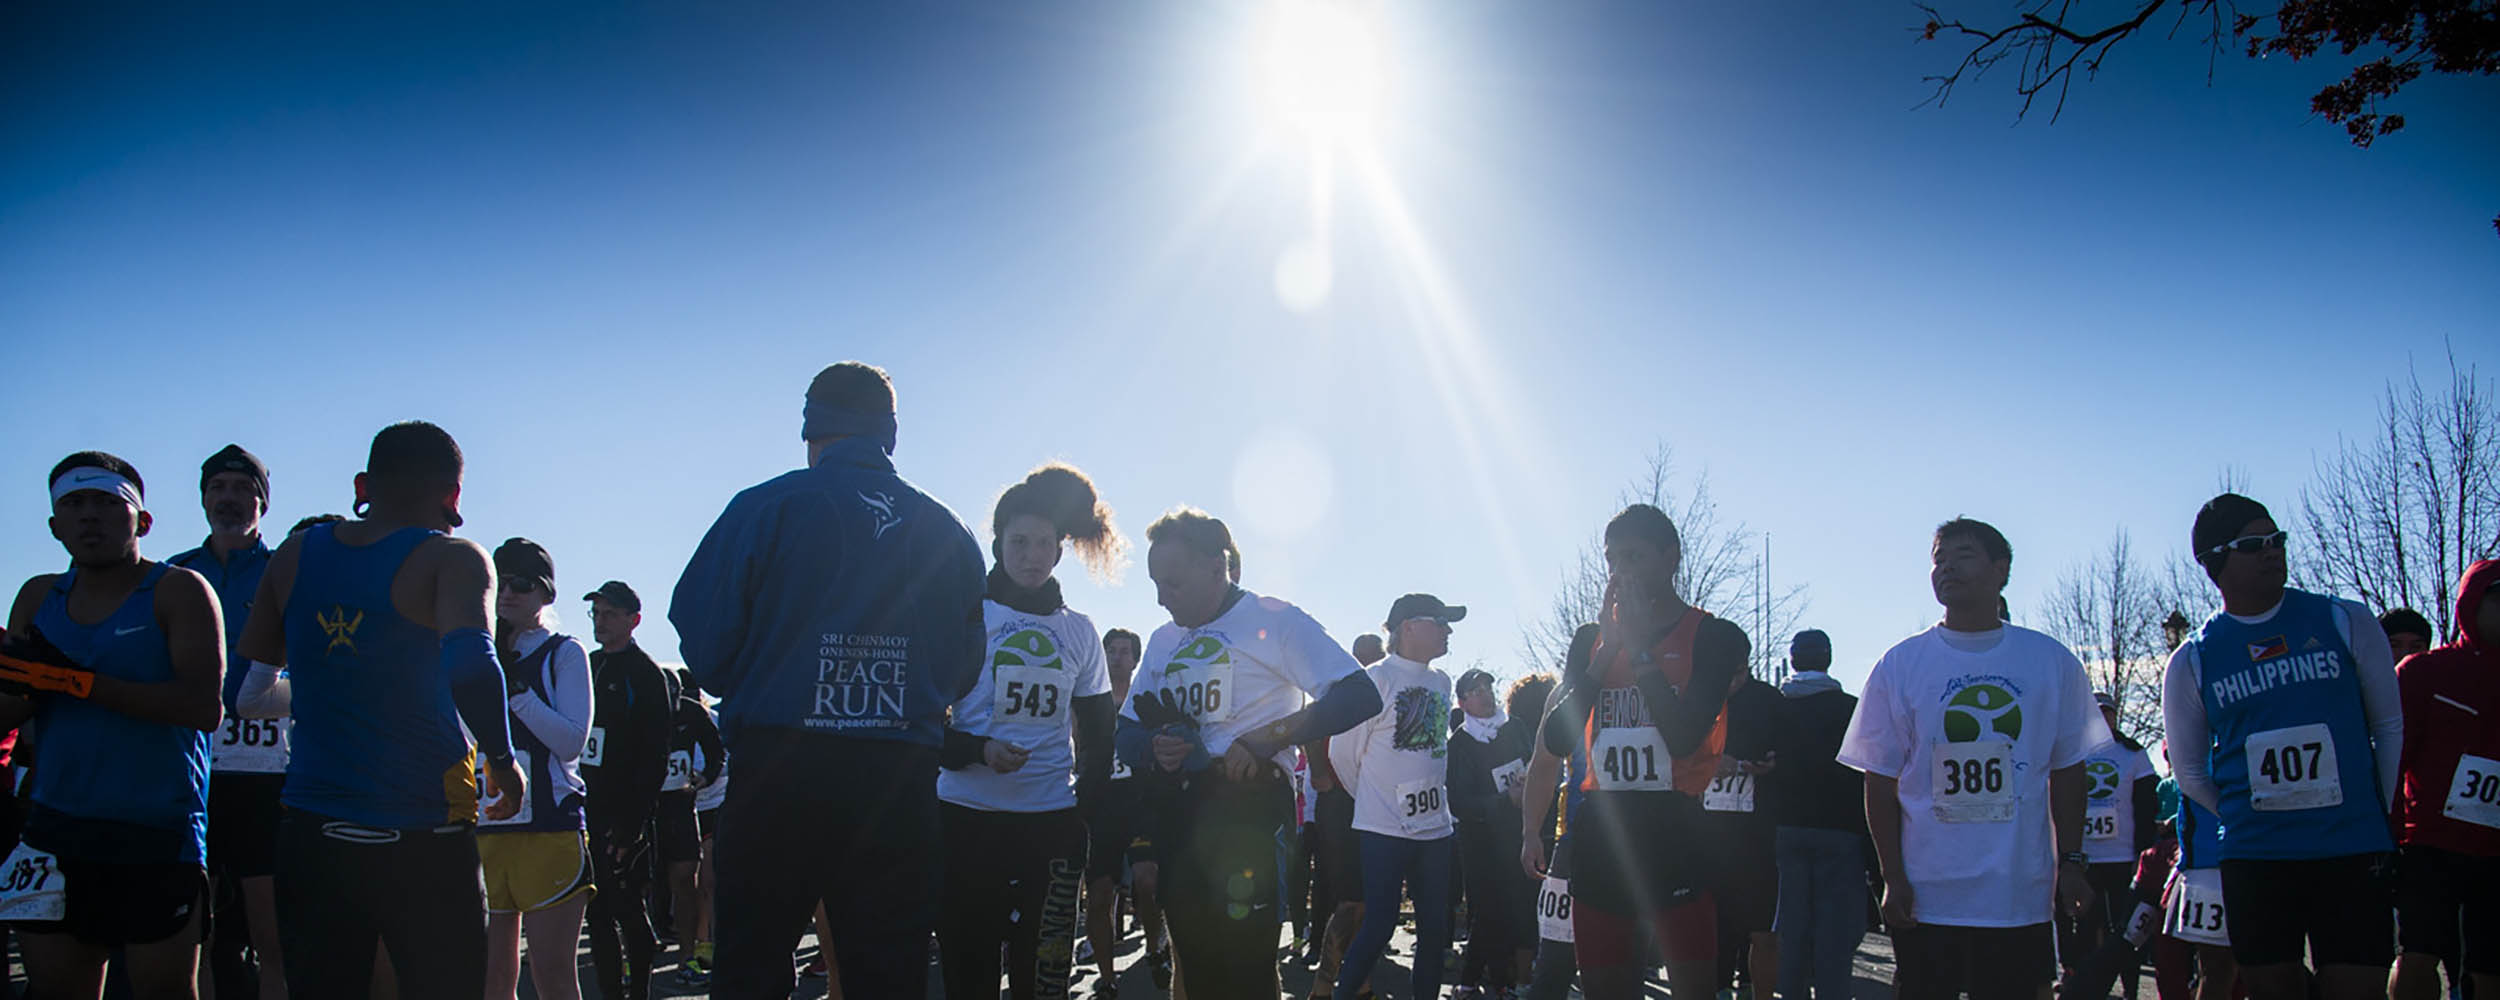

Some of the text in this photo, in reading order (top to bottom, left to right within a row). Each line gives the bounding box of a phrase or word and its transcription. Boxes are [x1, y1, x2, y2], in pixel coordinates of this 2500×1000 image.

[819, 646, 909, 660] ONENESS-HOME
[821, 632, 910, 648] SRI CHINMOY
[817, 658, 907, 686] PEACE
[2211, 649, 2341, 709] PHILIPPINES
[811, 681, 907, 718] RUN
[1004, 681, 1059, 718] 543
[1175, 678, 1222, 717] 296
[1599, 685, 1655, 727] EMO
[222, 716, 279, 746] 365
[666, 758, 687, 777] 54
[1604, 744, 1659, 782] 401
[1943, 757, 2003, 795] 386
[2260, 741, 2322, 784] 407
[1406, 787, 1440, 817] 390
[2460, 769, 2500, 806] 30
[2084, 816, 2114, 835] 545
